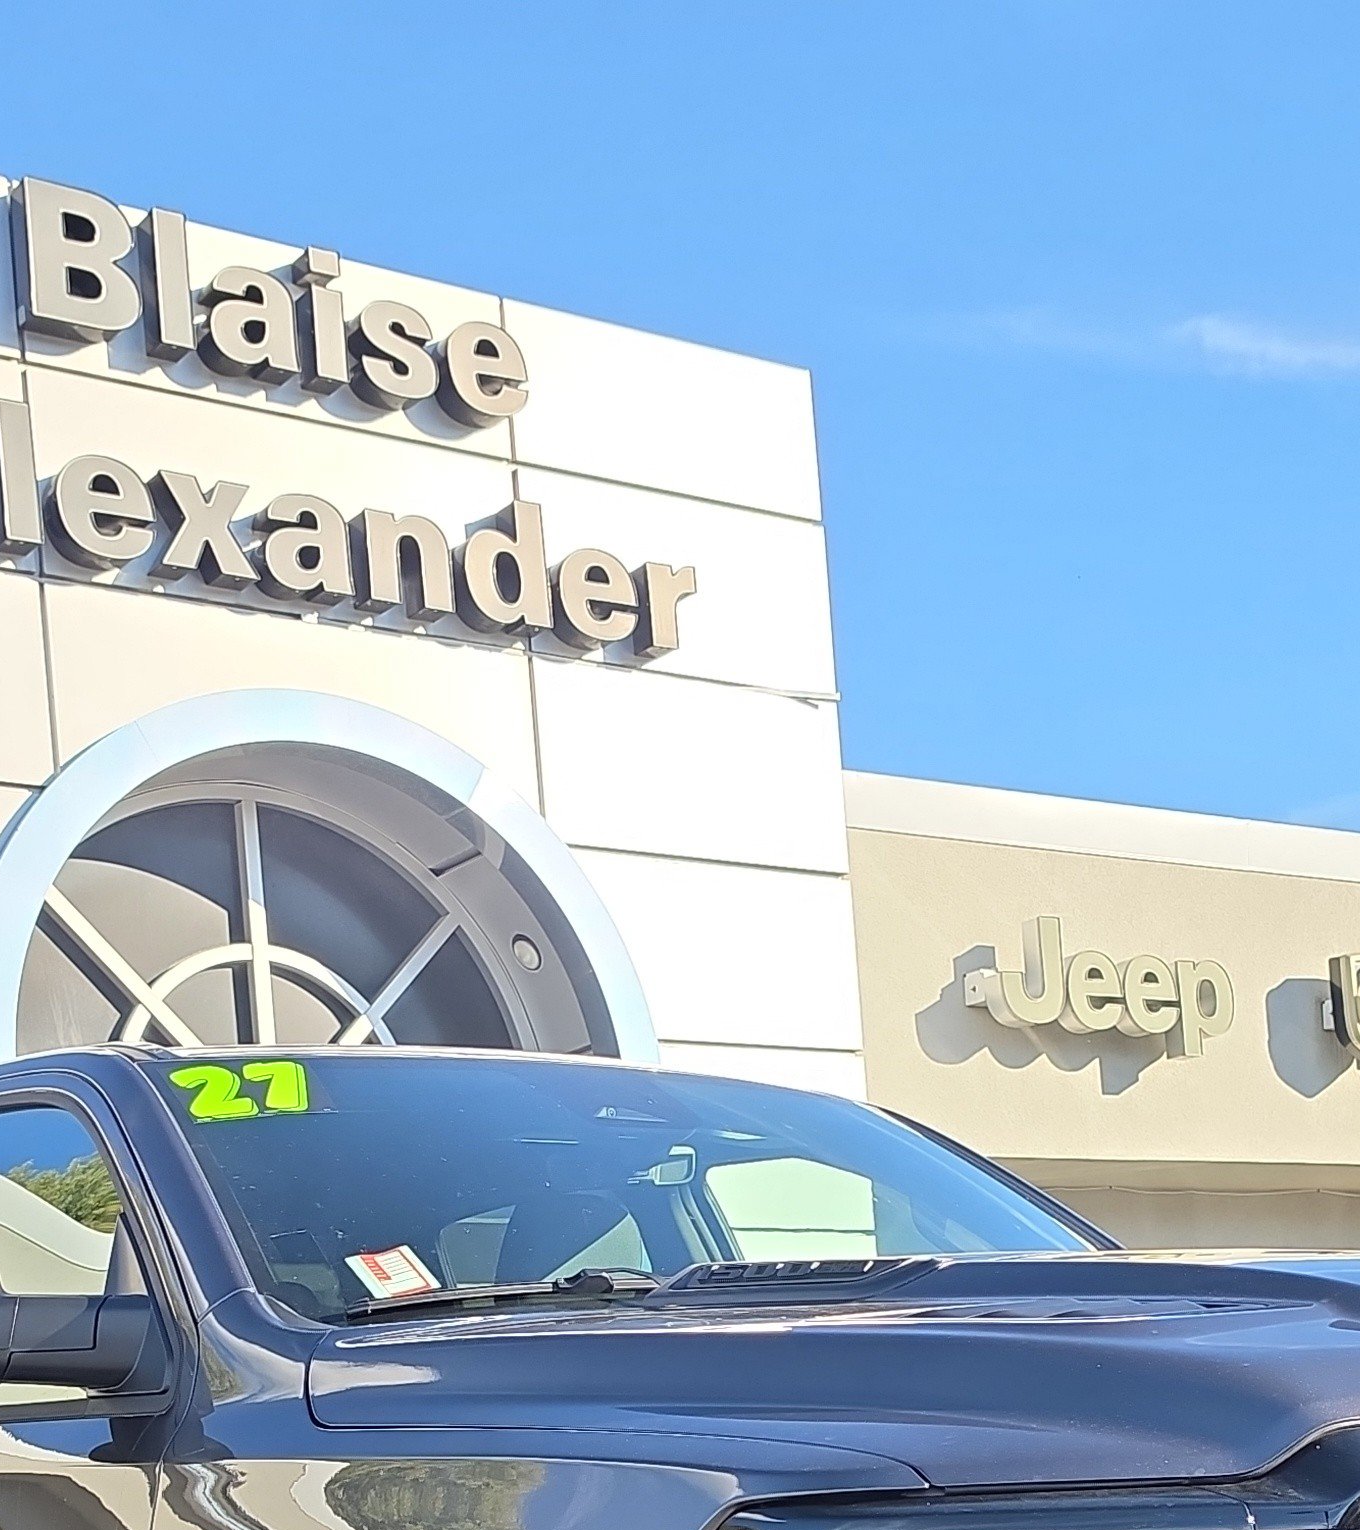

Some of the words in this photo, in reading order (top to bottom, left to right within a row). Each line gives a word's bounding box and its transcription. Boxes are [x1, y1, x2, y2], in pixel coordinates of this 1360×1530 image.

[20, 176, 529, 424] Blaise
[986, 916, 1235, 1058] Jeep
[169, 1061, 309, 1120] 27
